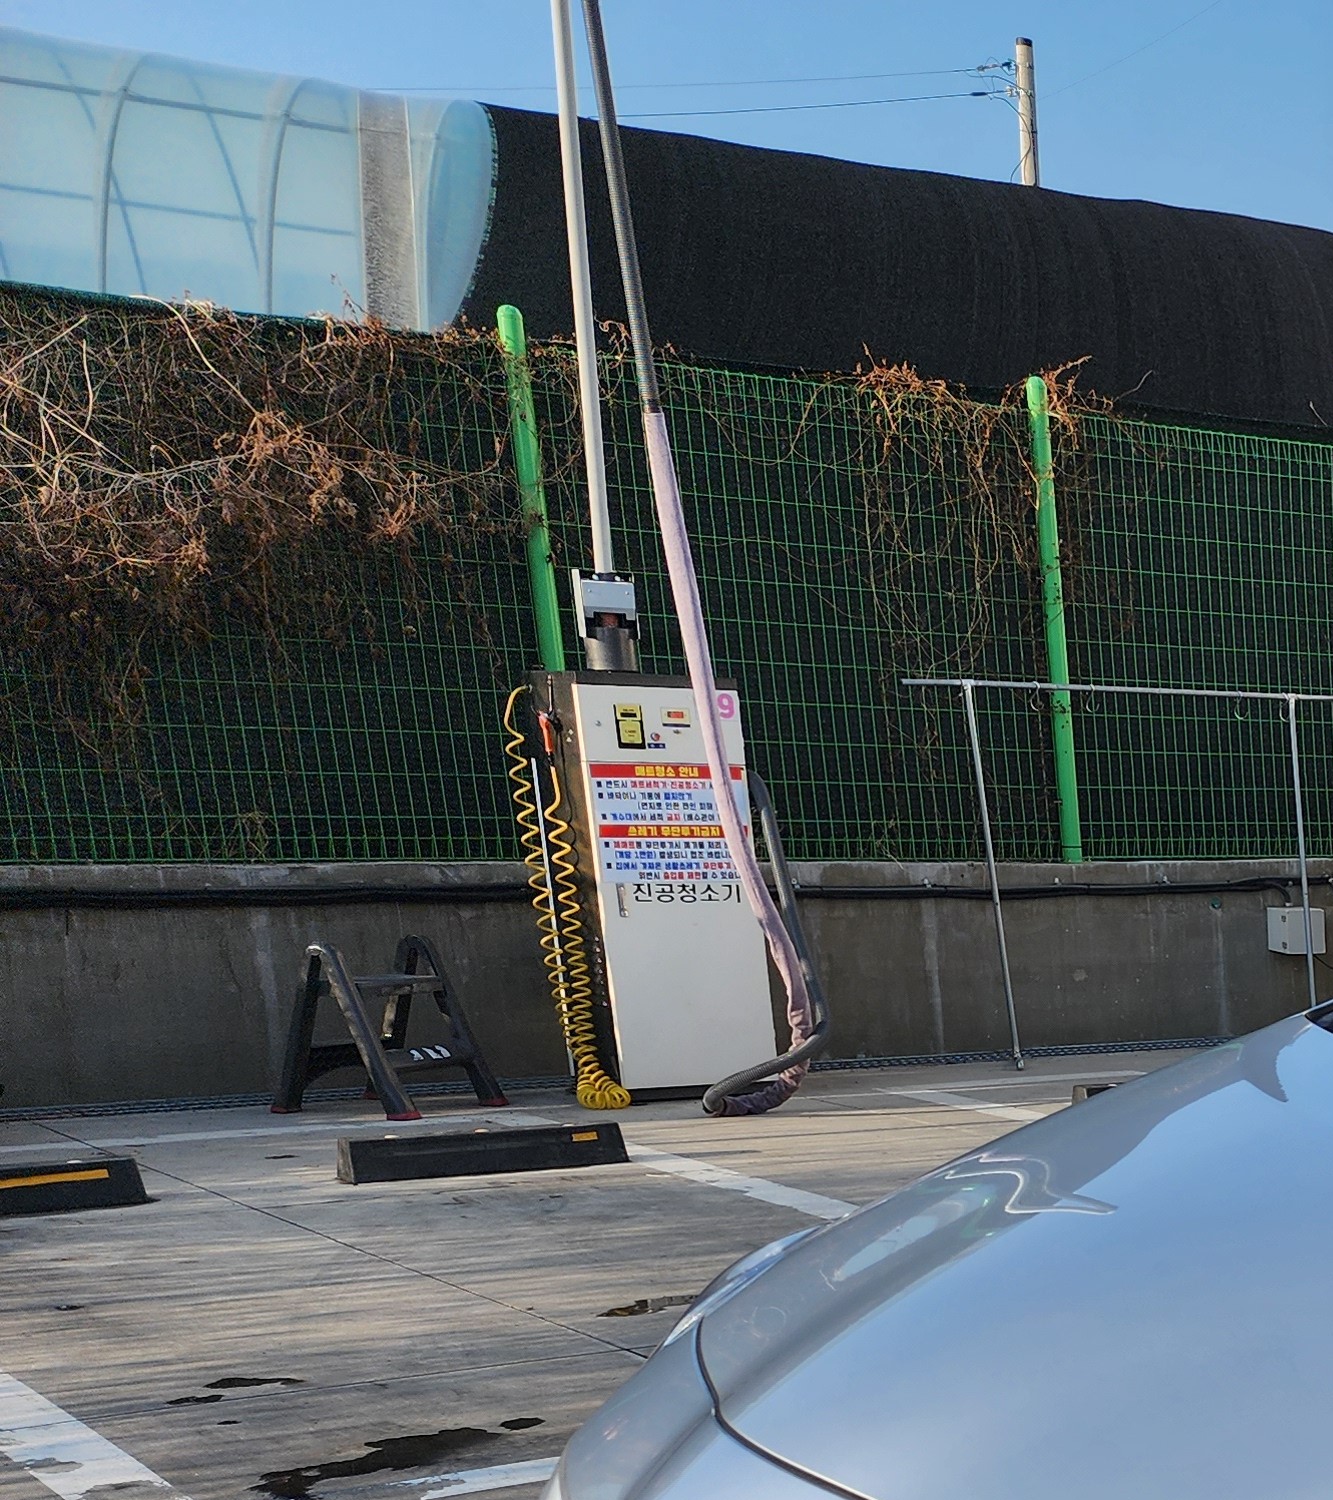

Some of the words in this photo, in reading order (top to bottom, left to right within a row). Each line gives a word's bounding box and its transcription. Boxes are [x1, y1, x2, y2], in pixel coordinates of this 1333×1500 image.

[717, 693, 735, 719] 9
[678, 767, 699, 778] 안내
[633, 883, 741, 903] 진공청소기
